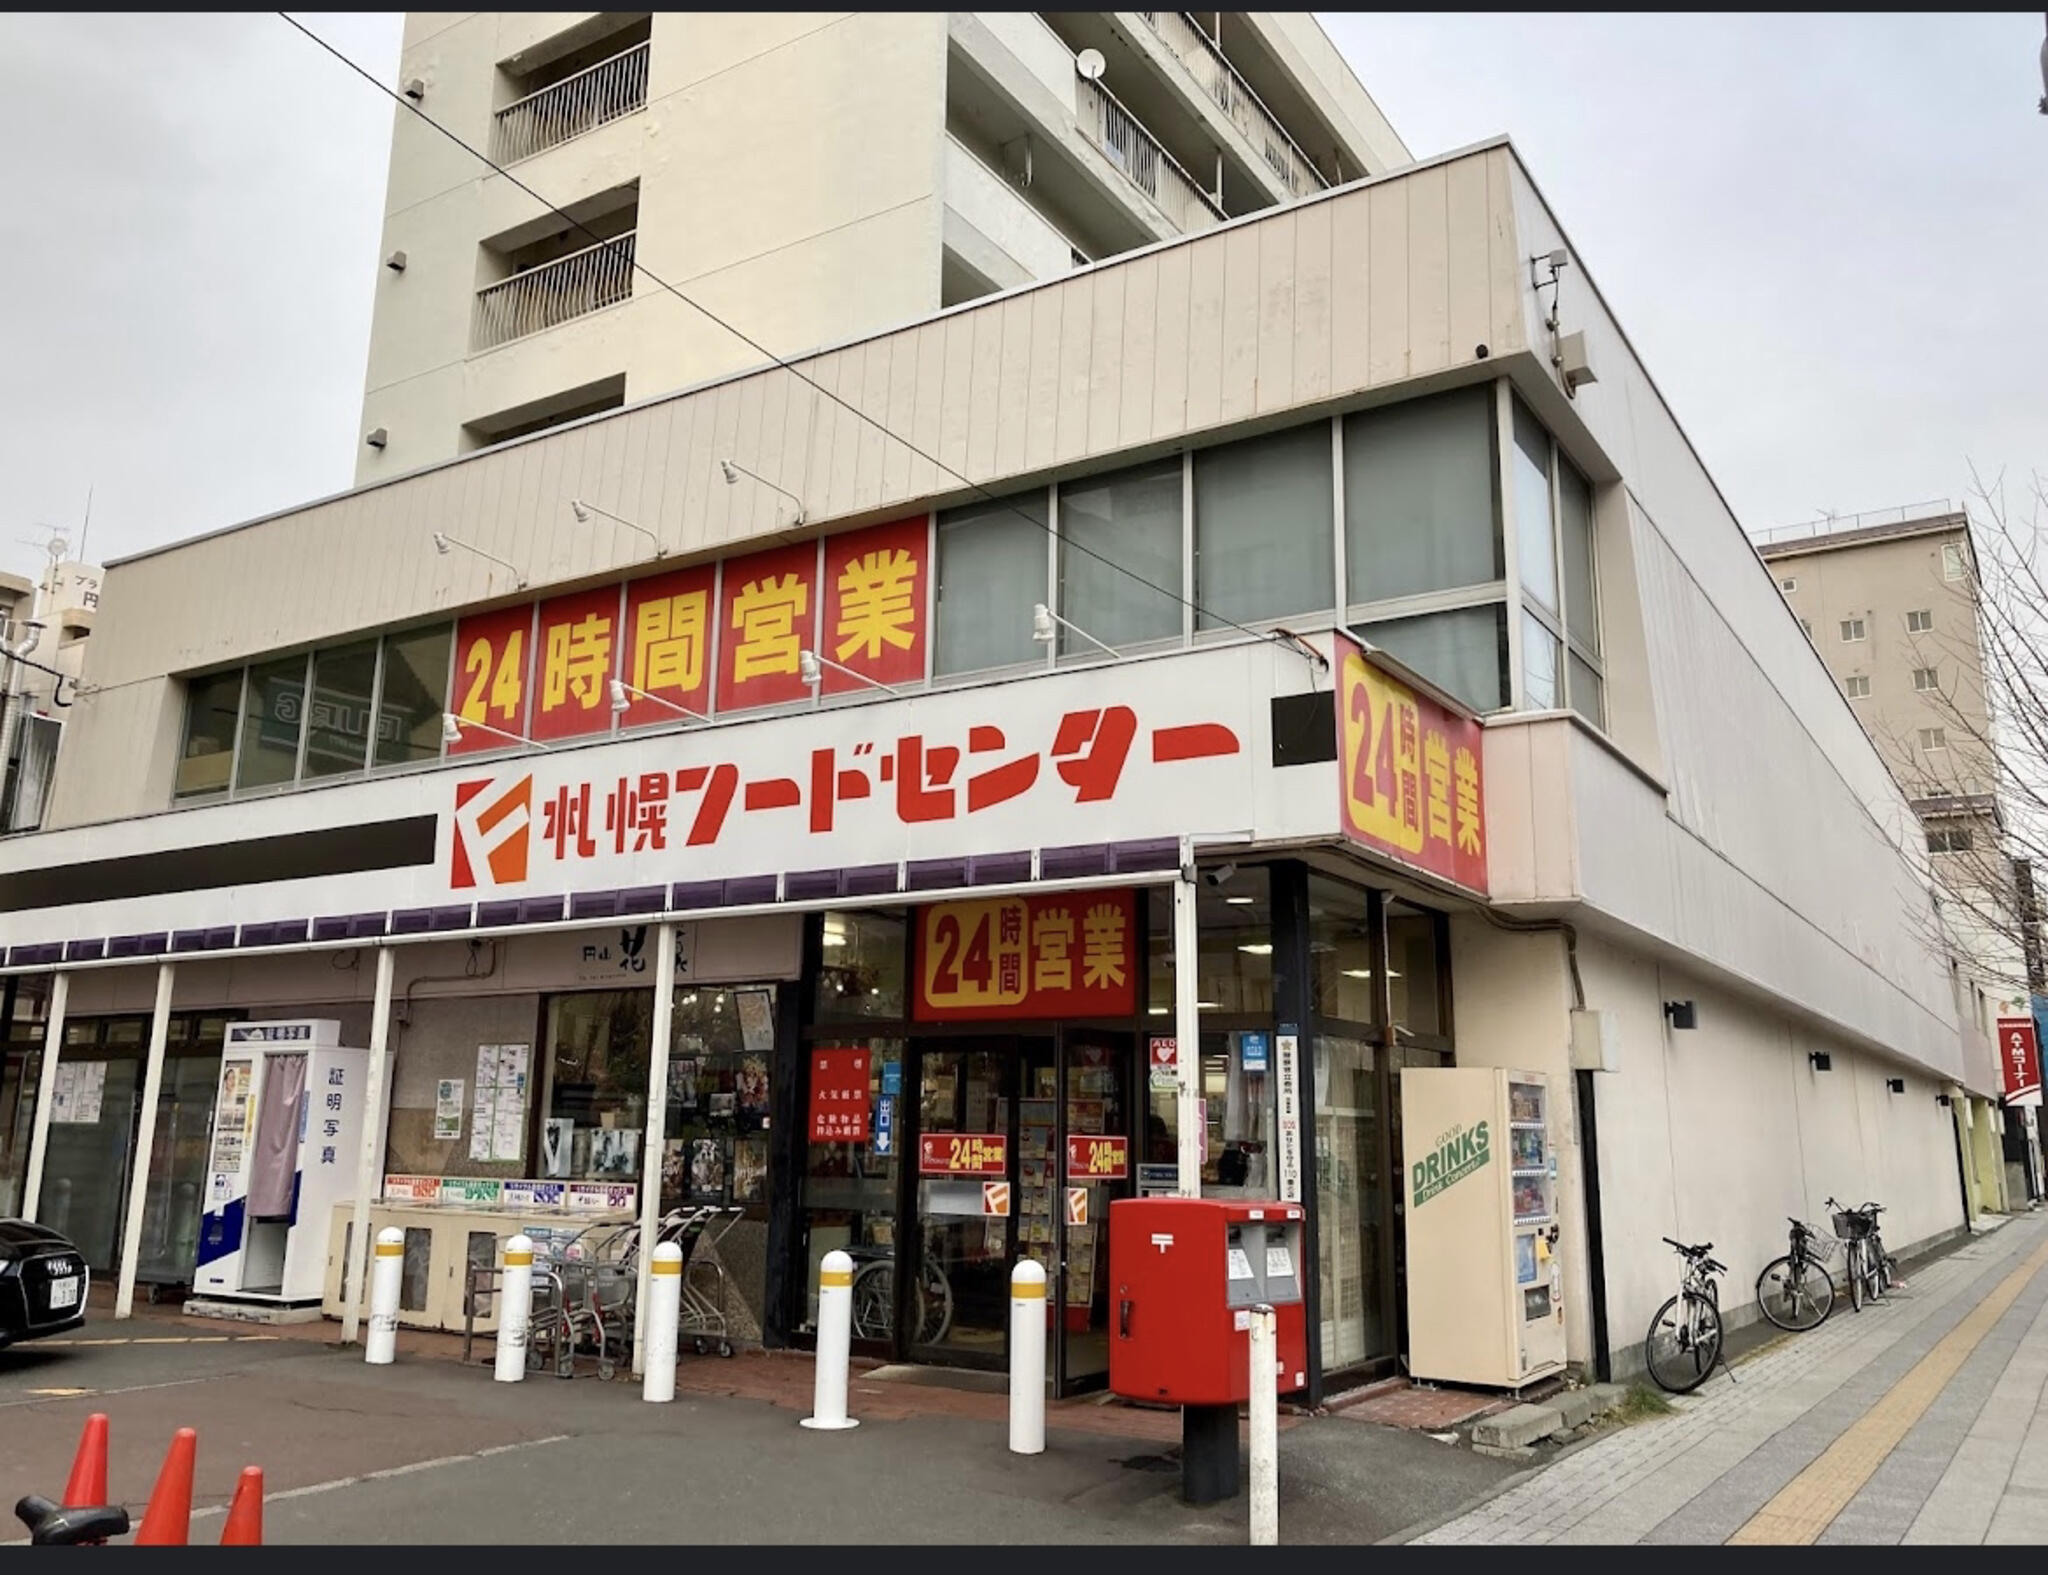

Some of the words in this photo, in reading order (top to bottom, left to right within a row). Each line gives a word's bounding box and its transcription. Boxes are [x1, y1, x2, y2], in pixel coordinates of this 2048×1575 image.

[457, 548, 918, 728] 24時間営業
[542, 705, 1240, 861] 札幌フードセンター
[1351, 682, 1481, 856] 24時間営業
[931, 903, 1126, 996] 24時間営業
[2010, 1032, 2029, 1088] ATMコーナー
[320, 1067, 345, 1164] 証明写真
[879, 1099, 890, 1126] 出口
[1412, 1120, 1489, 1193] DRINKS
